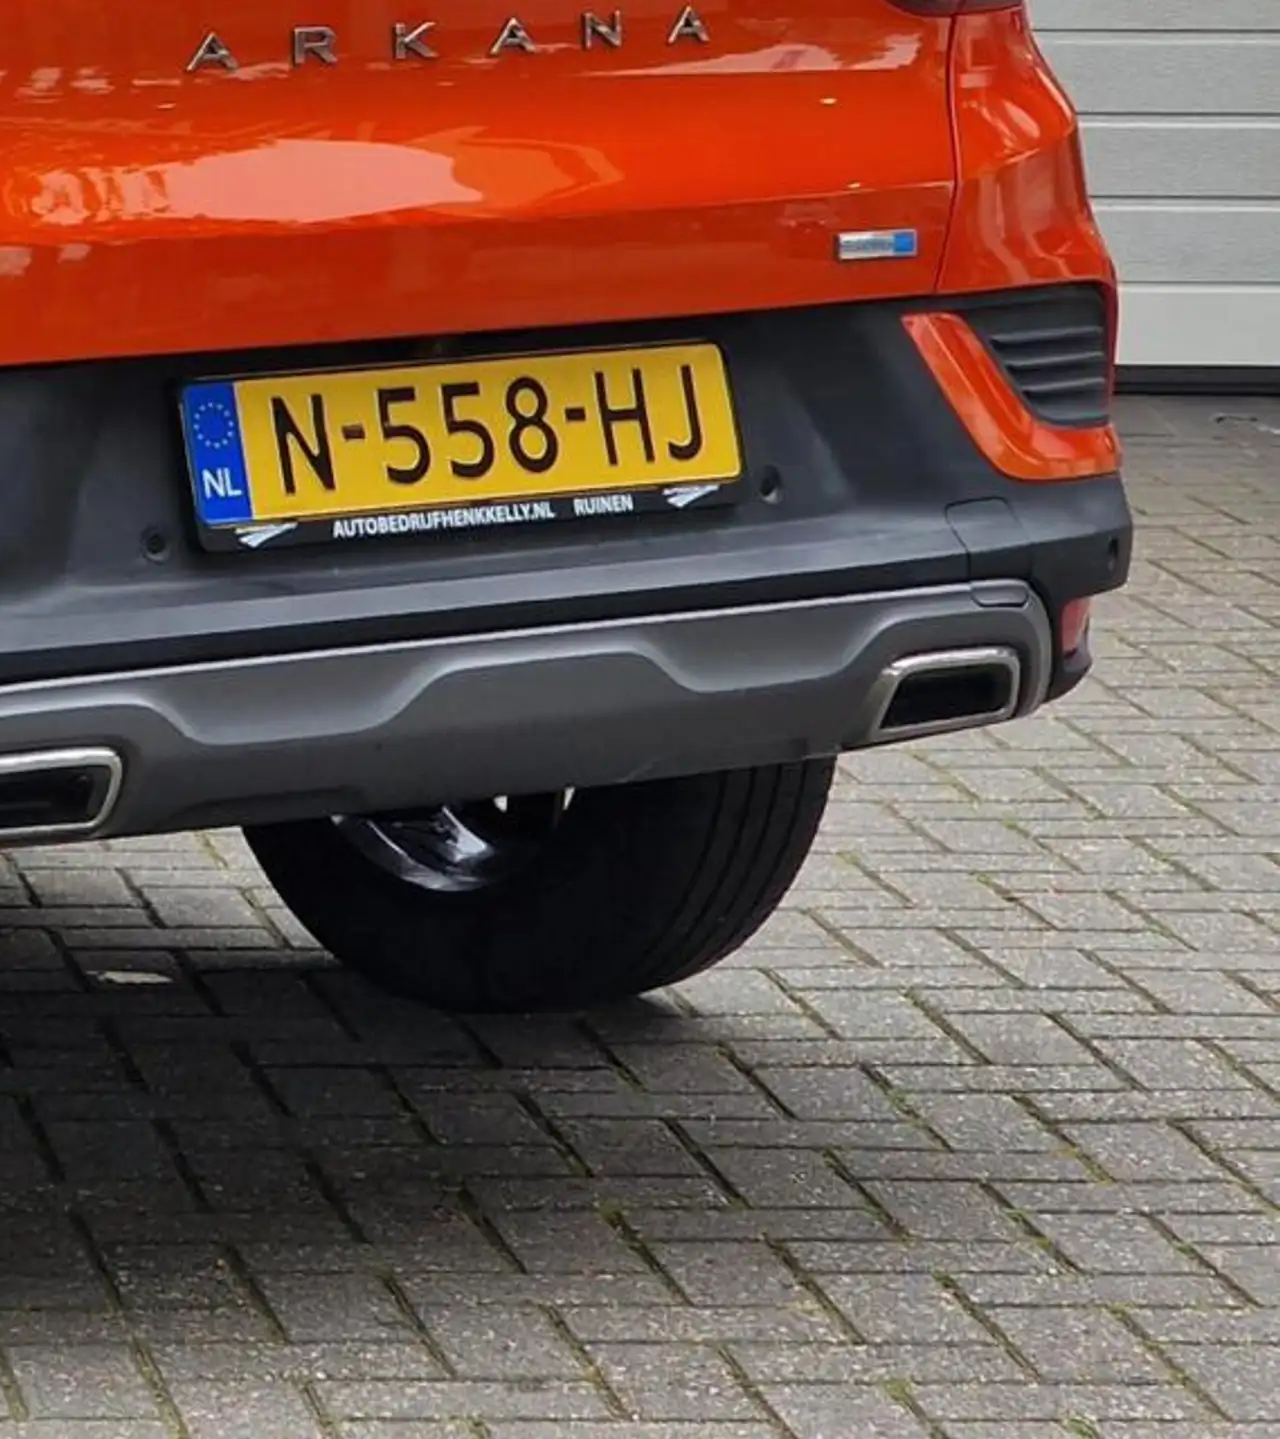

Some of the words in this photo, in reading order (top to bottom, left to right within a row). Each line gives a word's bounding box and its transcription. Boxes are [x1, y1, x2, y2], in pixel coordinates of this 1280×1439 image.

[186, 6, 709, 72] ARKANA
[201, 466, 242, 499] NL
[270, 364, 703, 495] N-558-HJ
[572, 493, 634, 516] RUINEN
